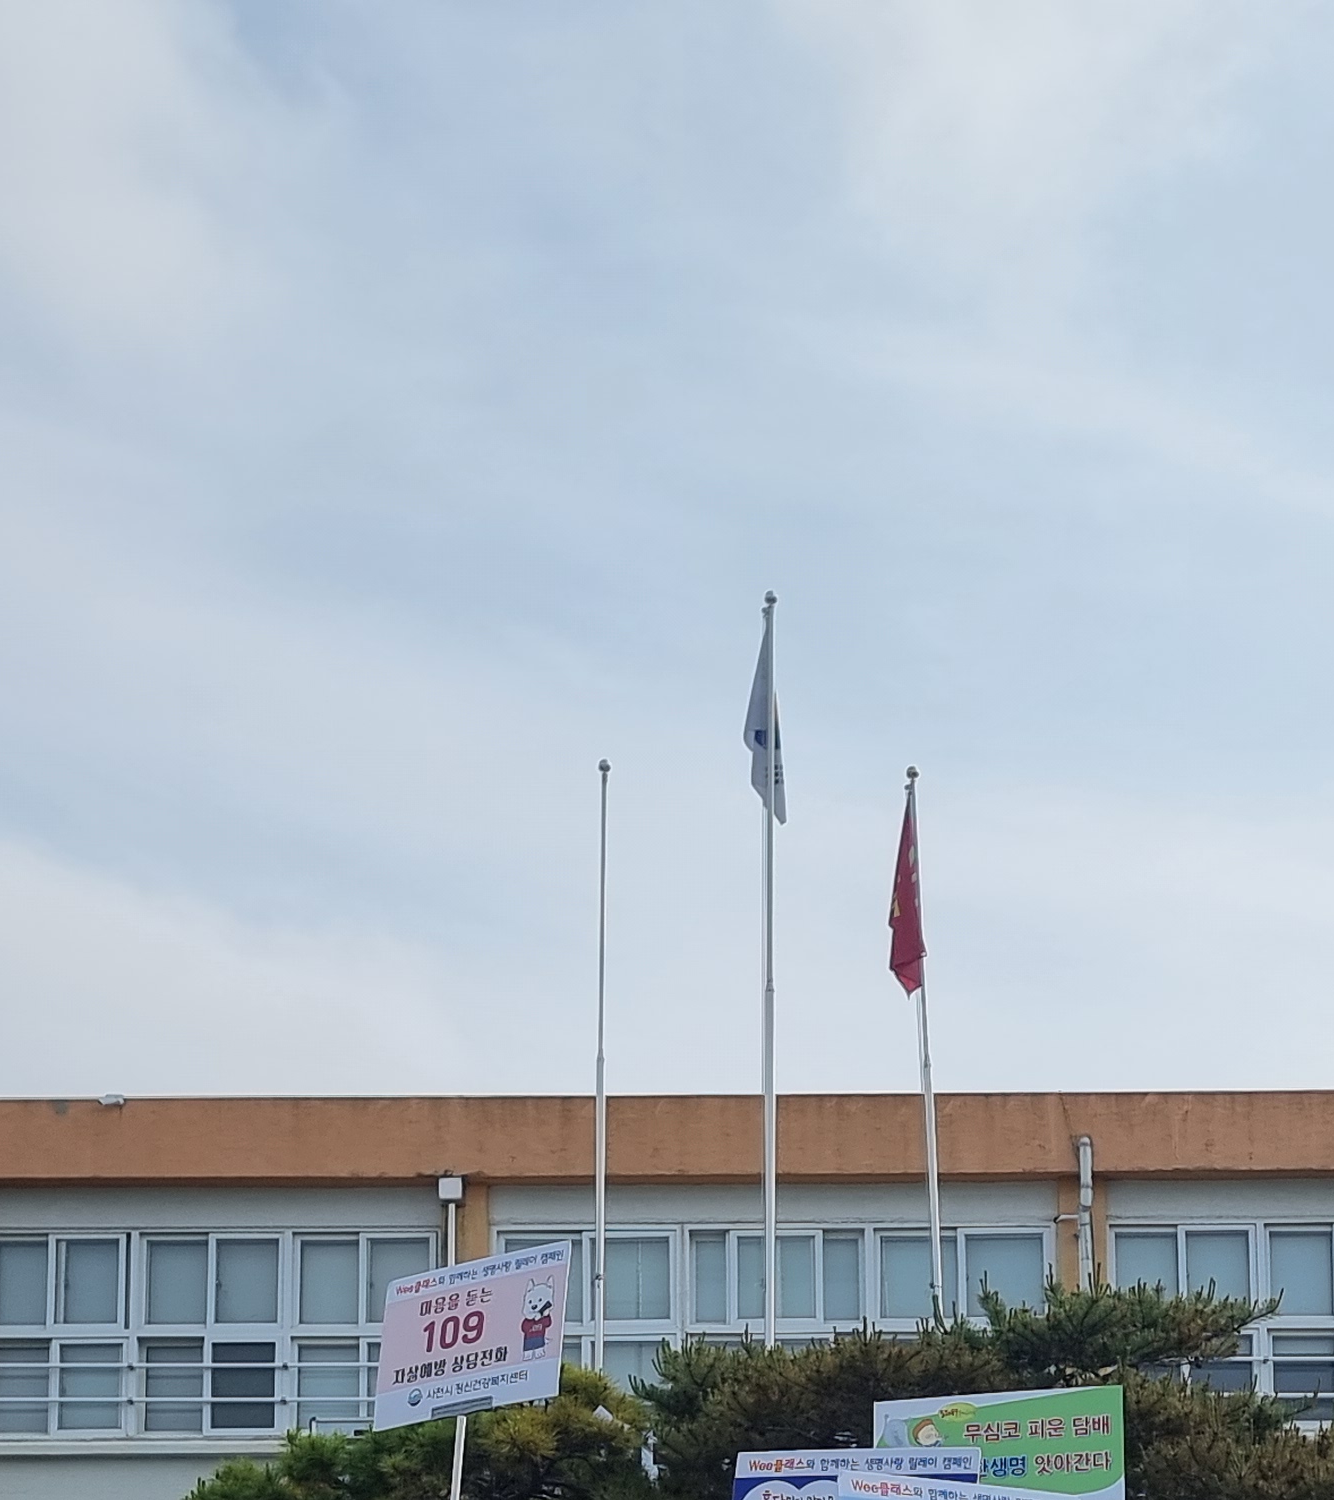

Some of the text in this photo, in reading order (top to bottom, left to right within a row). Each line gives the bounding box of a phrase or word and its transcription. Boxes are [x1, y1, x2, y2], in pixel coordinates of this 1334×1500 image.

[419, 1287, 493, 1316] 마음을 듣는
[423, 1310, 485, 1352] 109
[392, 1346, 508, 1386] 자살예방 상담전화
[425, 1370, 528, 1400] 사천시 정신건강복지센터
[963, 1415, 1111, 1443] 무심코 피운 담배
[820, 1458, 859, 1471] 함께하는
[865, 1457, 905, 1470] 생명사랑
[1034, 1451, 1112, 1476] 앗아간다
